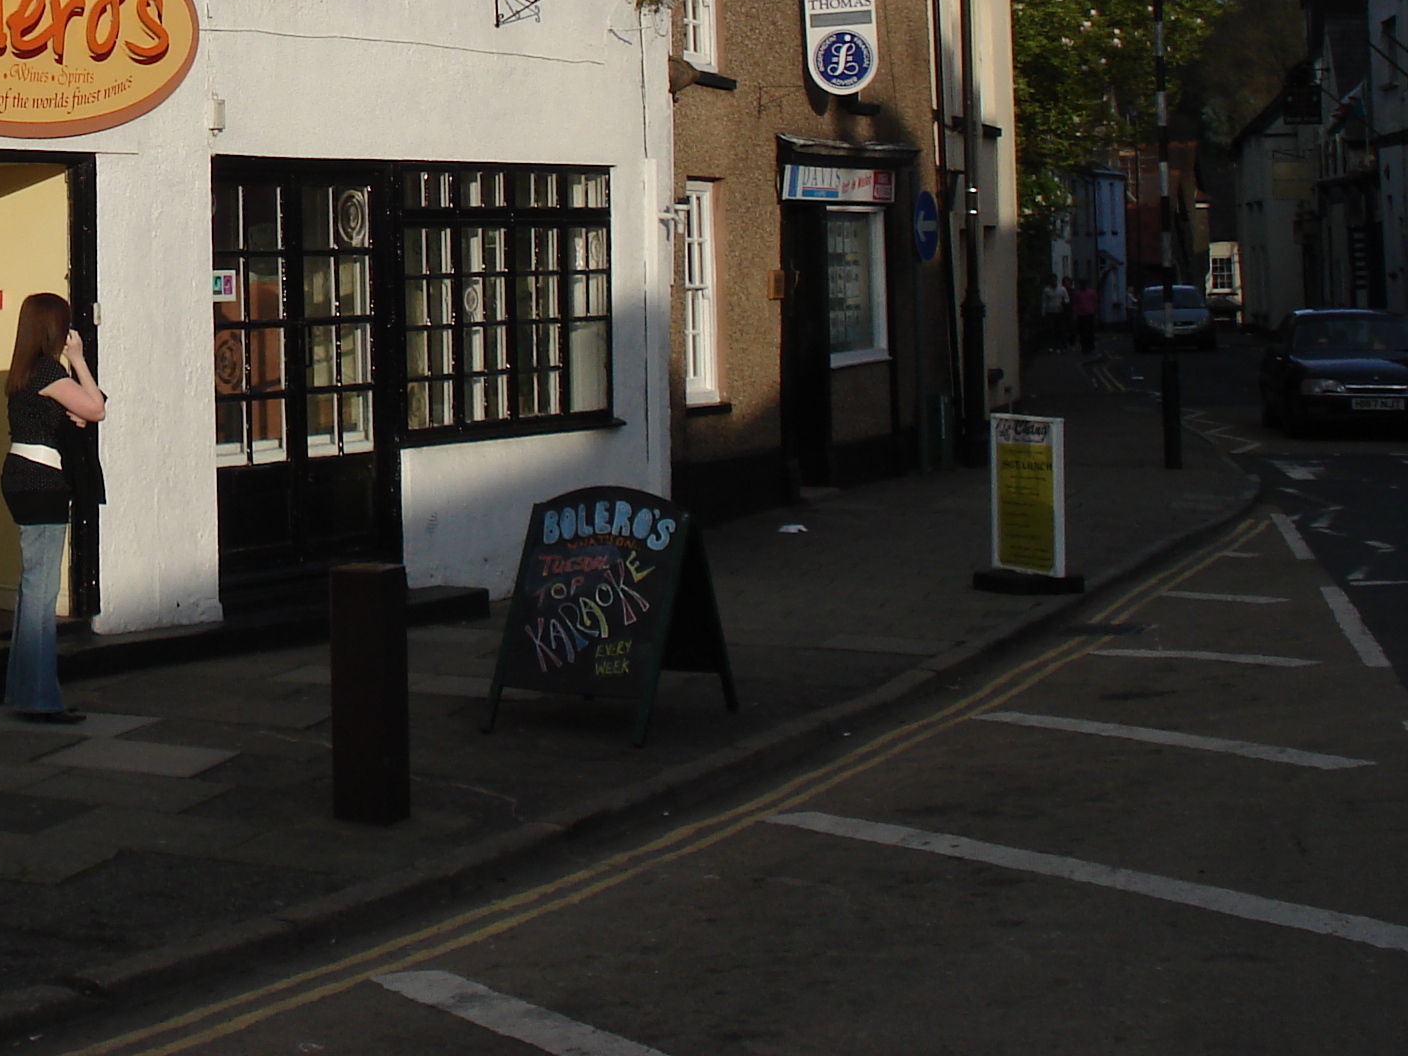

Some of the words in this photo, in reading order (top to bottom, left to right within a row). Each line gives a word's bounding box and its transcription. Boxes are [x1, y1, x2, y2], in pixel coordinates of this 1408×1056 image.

[9, 63, 50, 83] Wines
[57, 63, 95, 86] Spirits
[11, 90, 29, 110] the
[31, 87, 69, 110] worlds
[67, 84, 102, 115] finest
[103, 75, 133, 99] wines
[802, 167, 841, 188] DAVIS
[543, 500, 676, 551] BOLERO'S
[534, 576, 585, 608] TOP
[524, 550, 655, 672] KARAOKE
[595, 640, 633, 659] EVERY
[595, 658, 630, 676] WEEK
